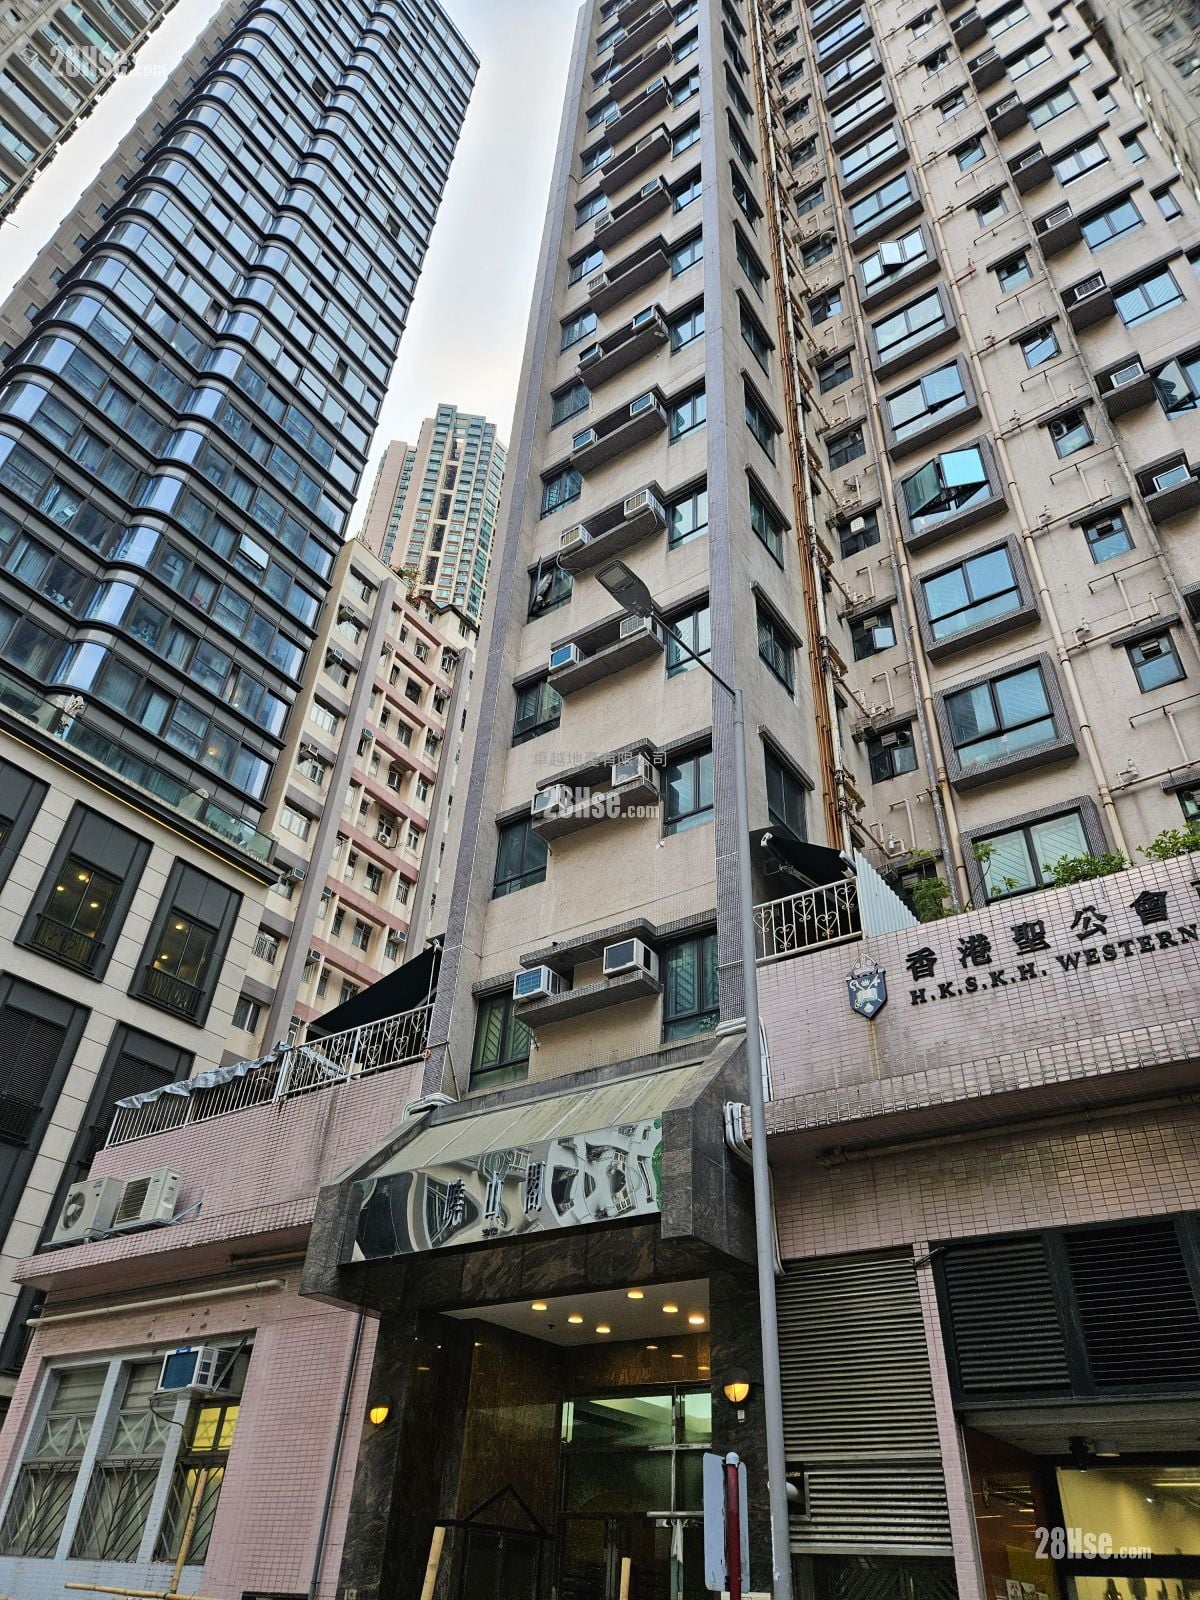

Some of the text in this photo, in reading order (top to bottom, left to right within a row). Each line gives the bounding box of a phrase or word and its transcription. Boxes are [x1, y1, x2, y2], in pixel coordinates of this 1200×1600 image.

[905, 880, 1200, 982] 香港聖公會
[1055, 923, 1199, 972] WESTERN
